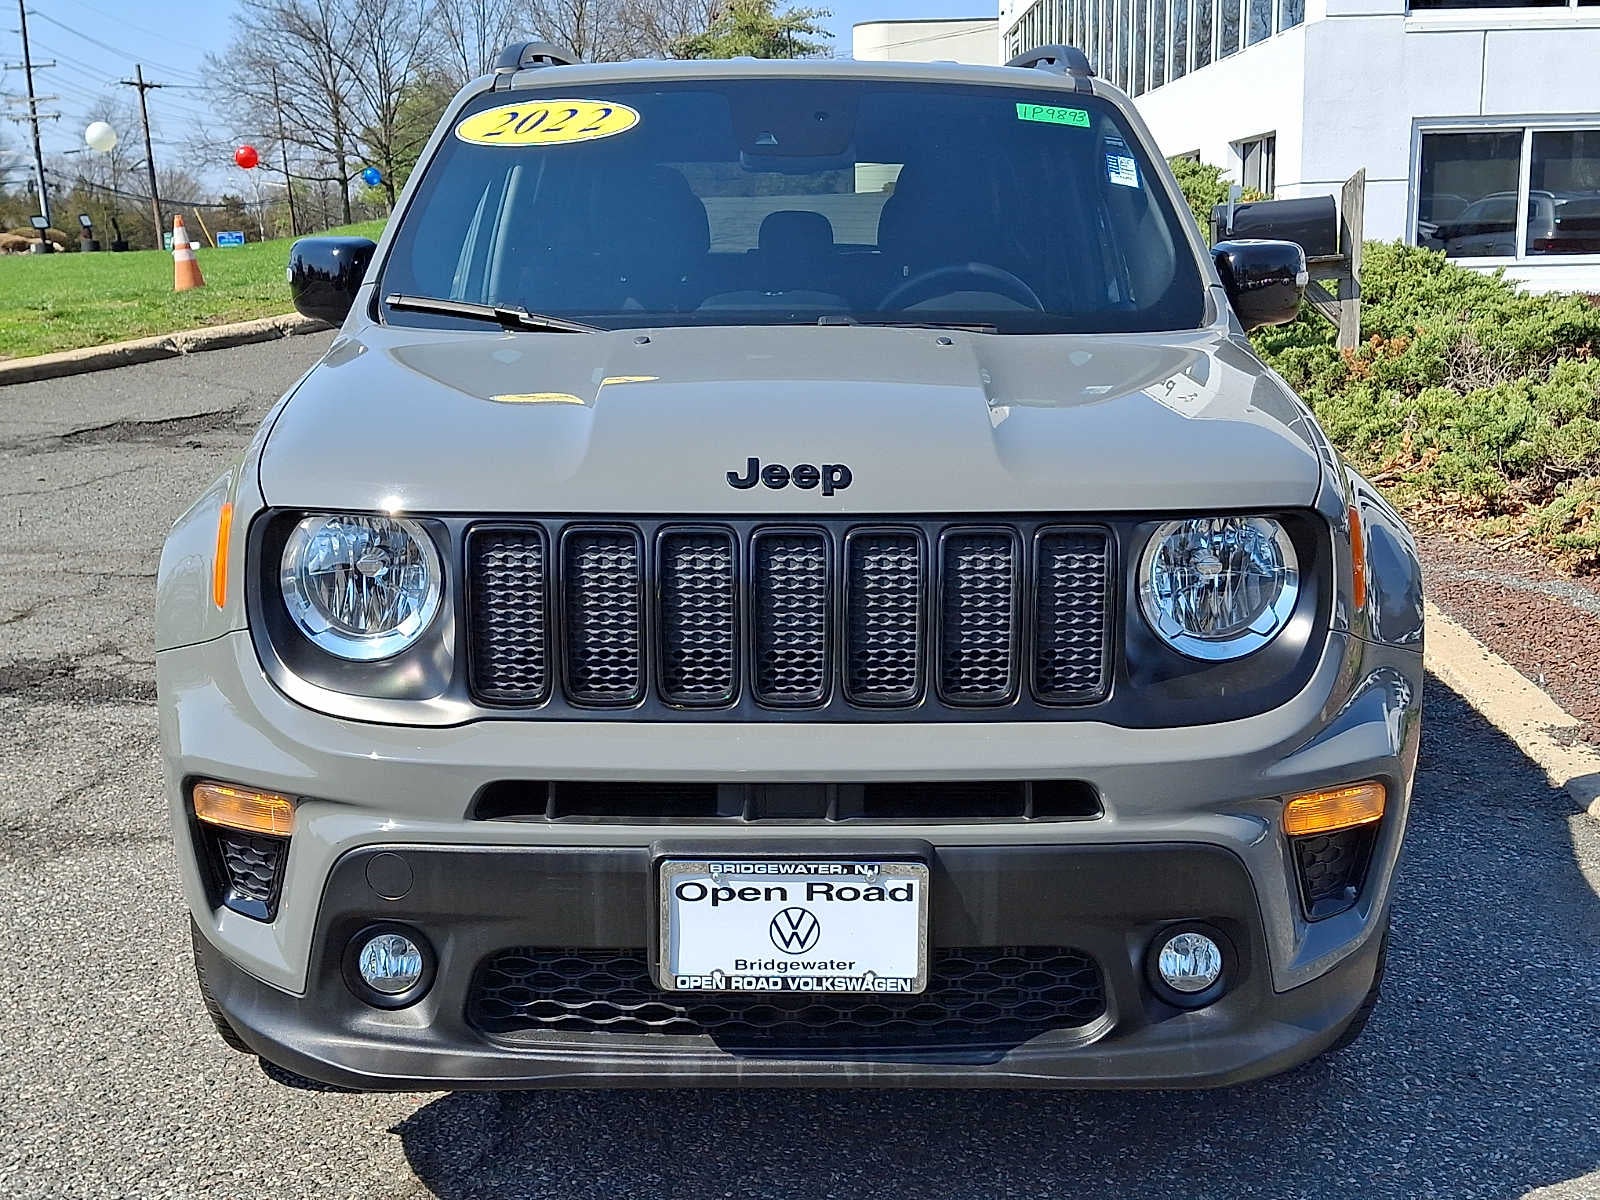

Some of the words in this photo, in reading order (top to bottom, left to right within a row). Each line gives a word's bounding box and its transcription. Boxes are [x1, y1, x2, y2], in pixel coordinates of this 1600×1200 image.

[482, 108, 613, 137] 2022
[726, 457, 853, 497] Jeep
[709, 864, 848, 875] BRIDGEWATER,
[675, 882, 788, 907] Open
[806, 882, 914, 902] Road
[771, 908, 819, 952] VW
[734, 958, 856, 974] Bridgewater
[676, 976, 726, 990] OPEN
[731, 976, 782, 990] ROAD
[787, 977, 912, 992] VOLKSWAGEN
